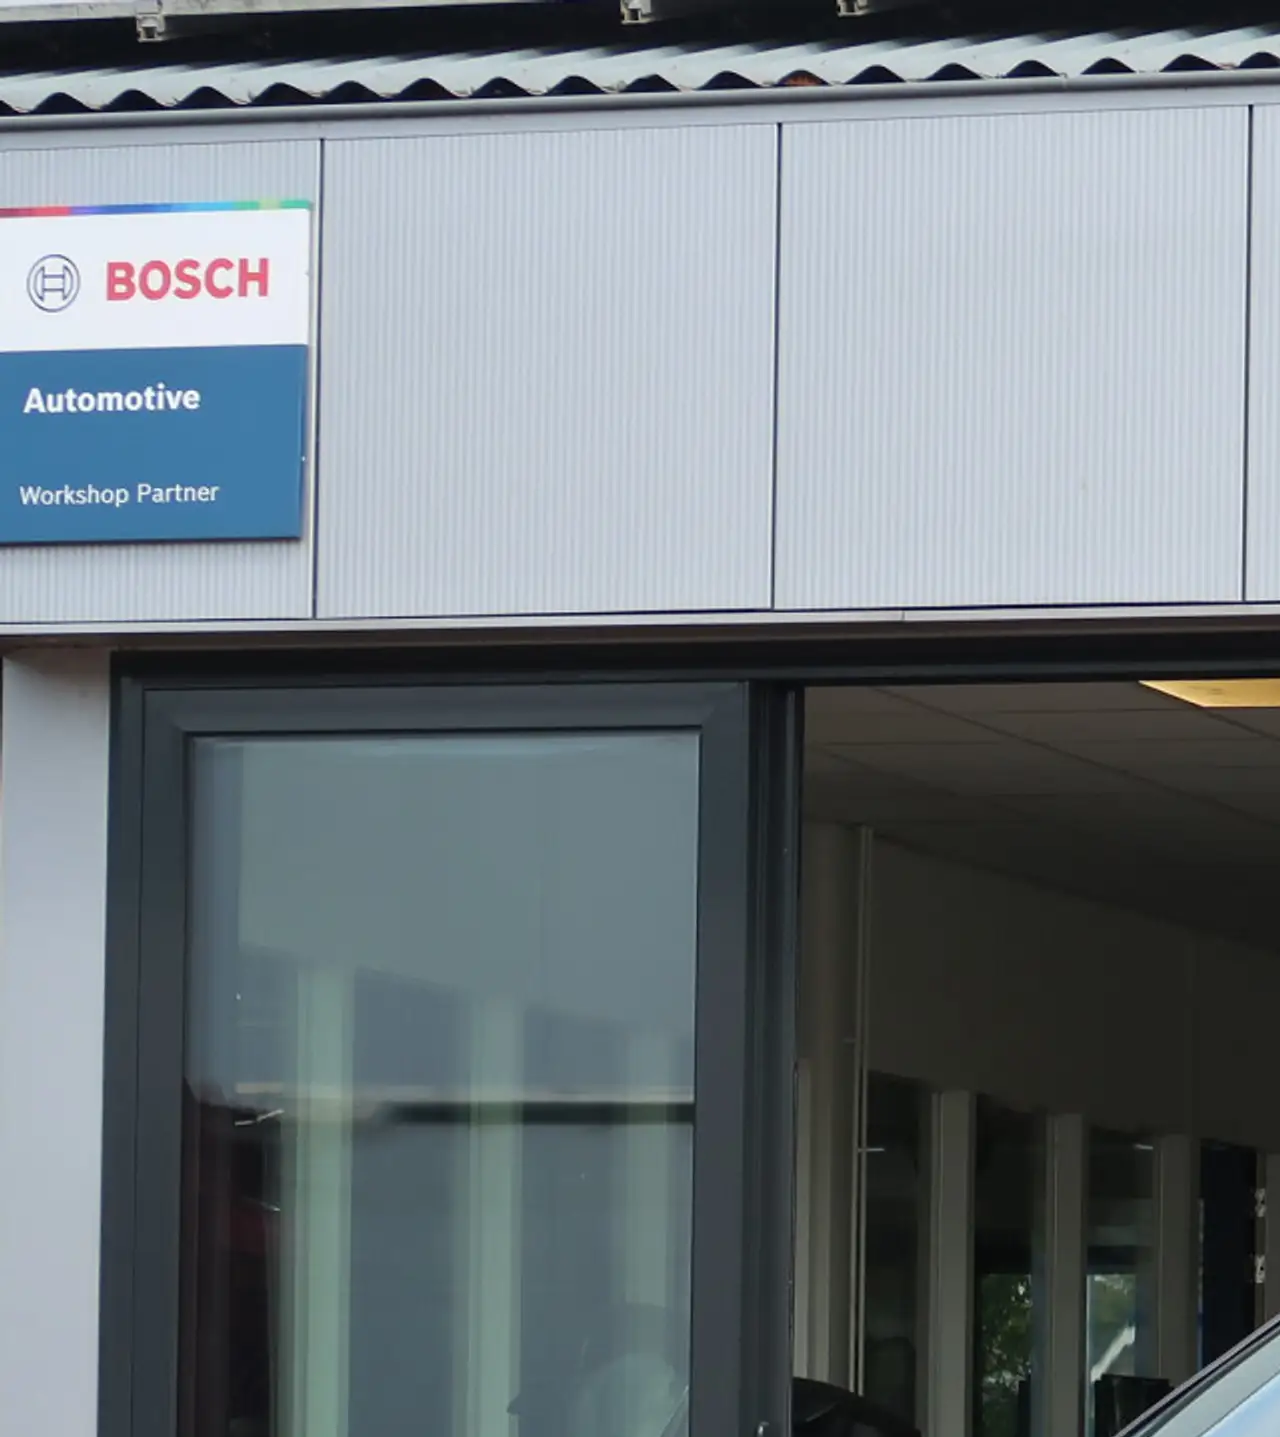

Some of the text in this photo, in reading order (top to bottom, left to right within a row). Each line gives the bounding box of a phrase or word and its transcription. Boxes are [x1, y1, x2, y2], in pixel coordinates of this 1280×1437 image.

[105, 256, 270, 302] BOSCH
[23, 383, 202, 414] Automotive
[19, 483, 220, 508] Workshop Partner
